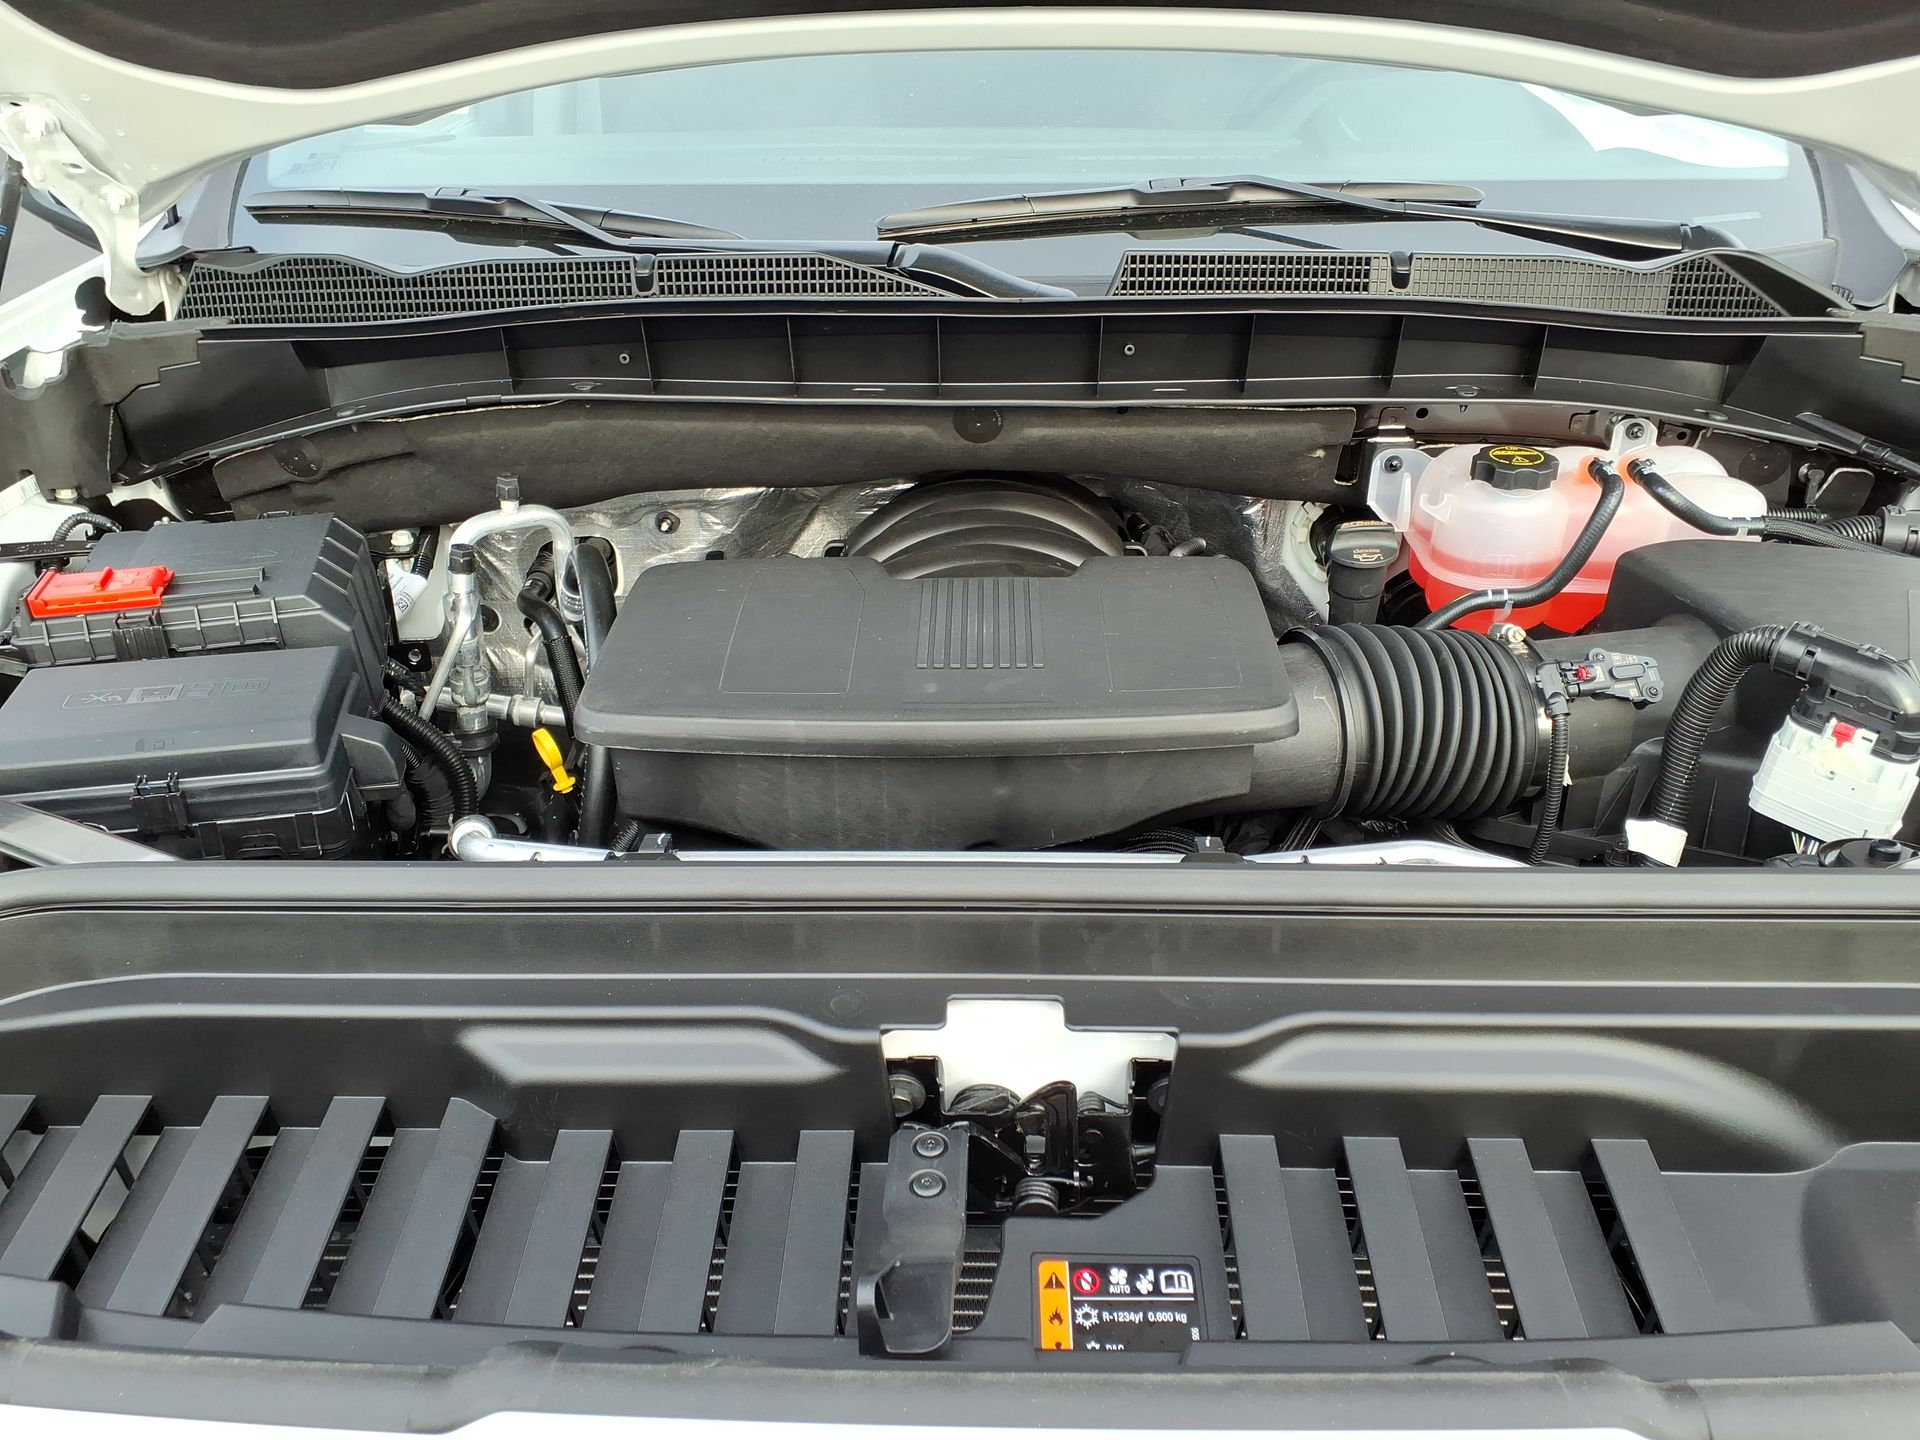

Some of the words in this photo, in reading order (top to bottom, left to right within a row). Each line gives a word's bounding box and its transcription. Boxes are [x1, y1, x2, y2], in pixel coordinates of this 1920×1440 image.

[1109, 1284, 1131, 1294] AUTO
[1102, 1311, 1143, 1323] R-1234yf
[1147, 1311, 1173, 1322] 0.600
[1175, 1312, 1188, 1323] kg
